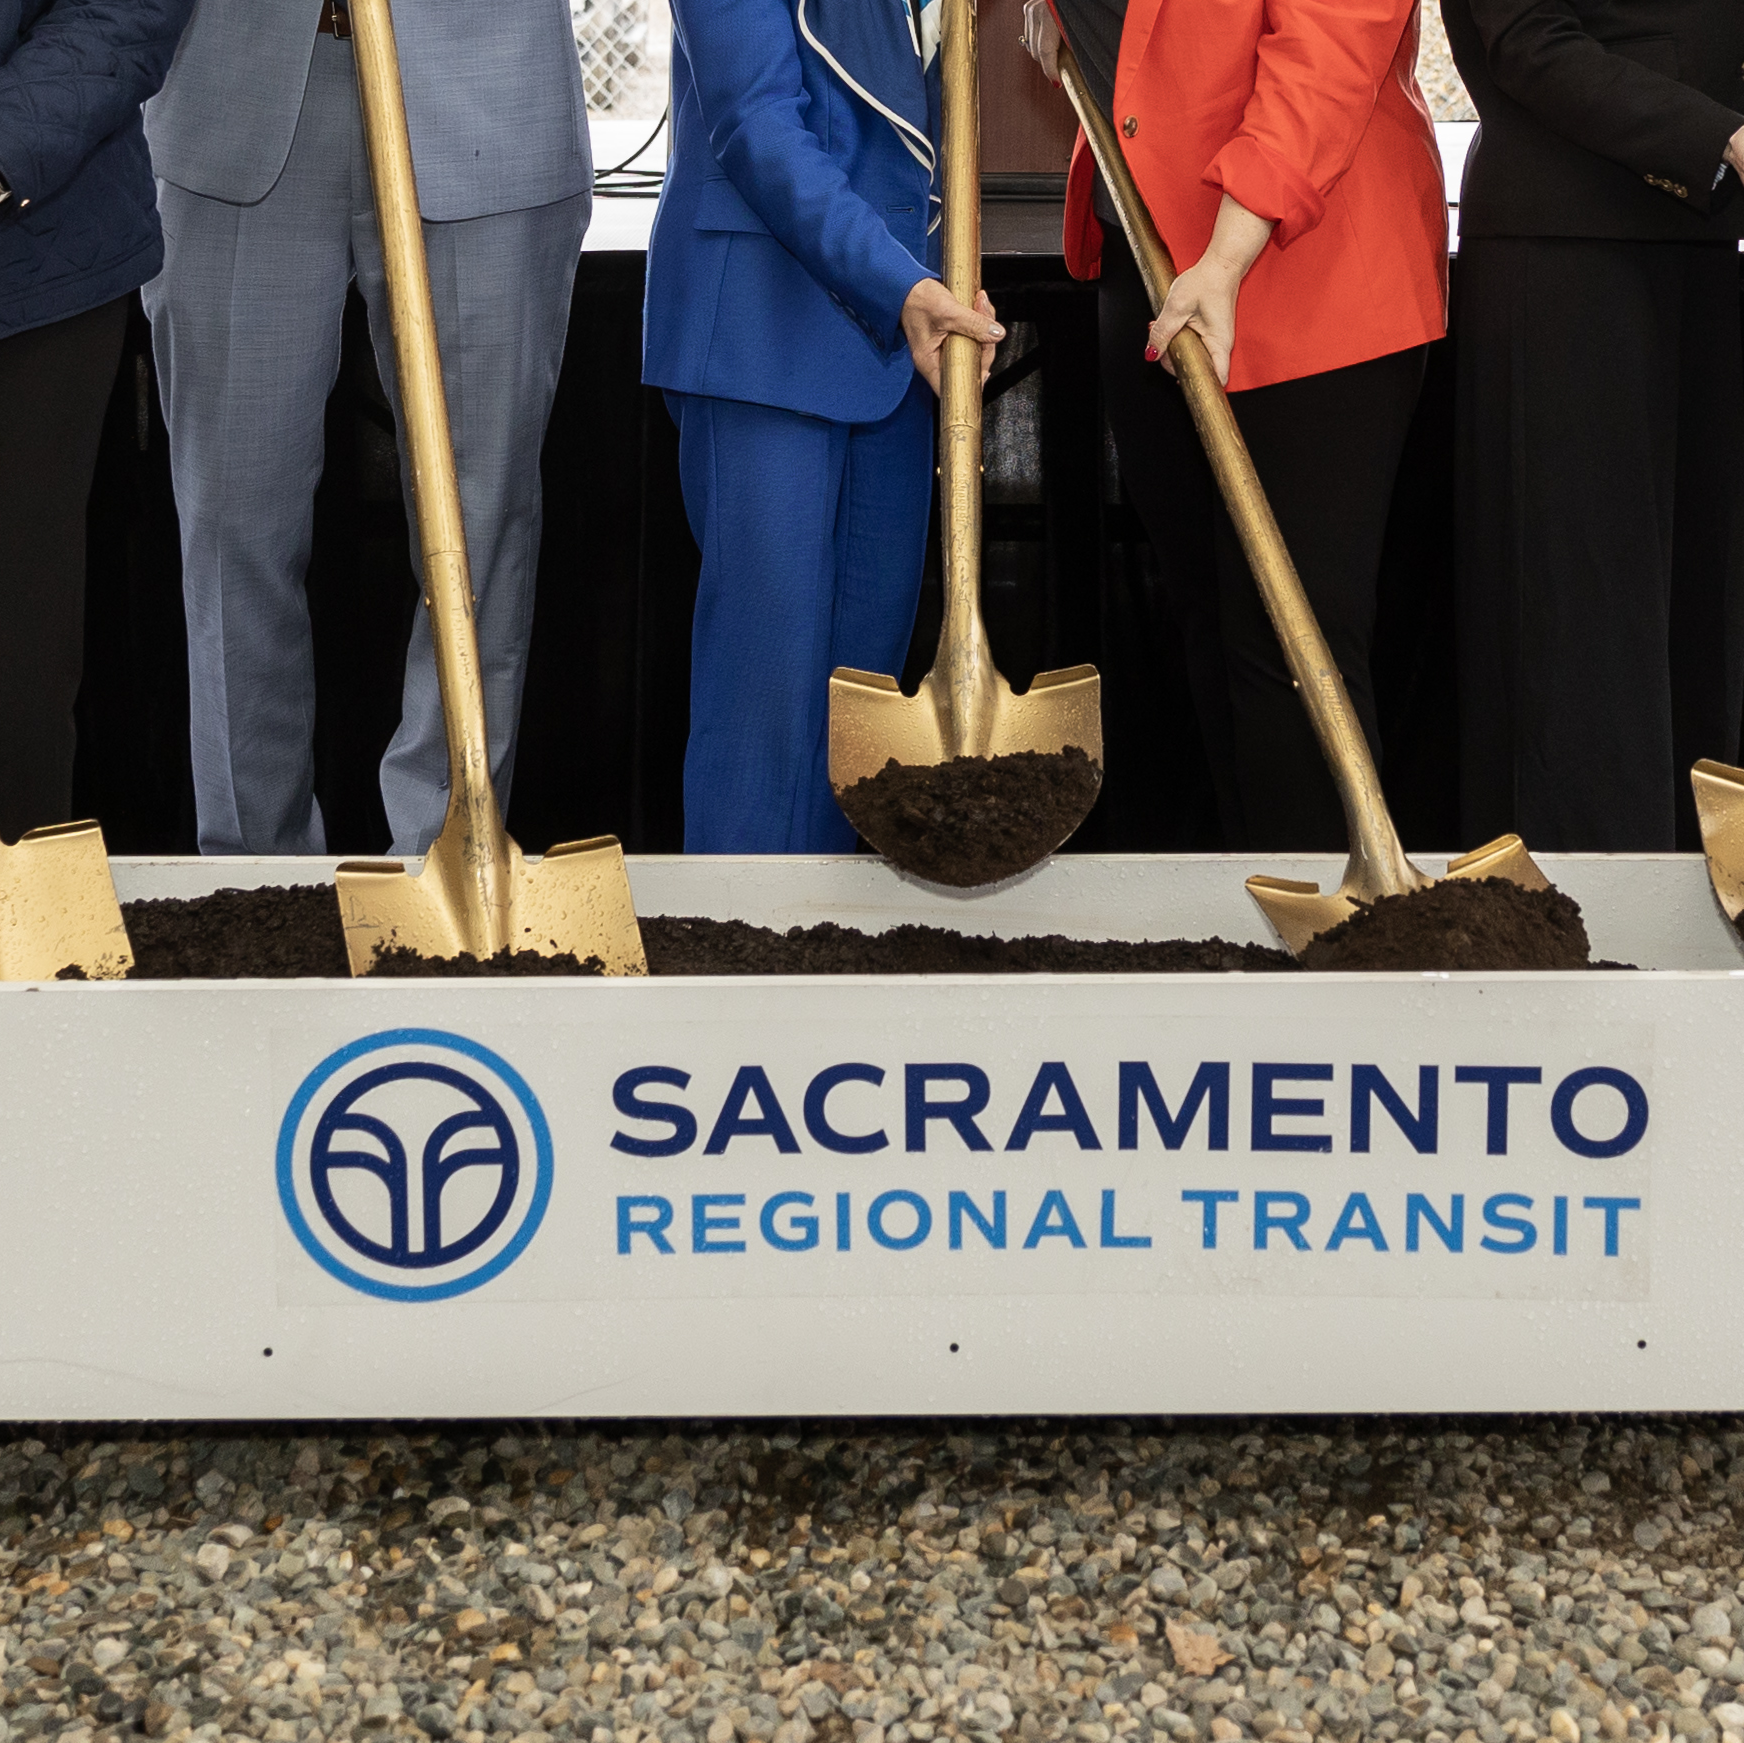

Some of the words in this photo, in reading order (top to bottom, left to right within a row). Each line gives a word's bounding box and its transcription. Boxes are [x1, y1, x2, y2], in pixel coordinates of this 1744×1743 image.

[609, 1060, 1650, 1159] SACRAMENTO
[615, 1188, 1153, 1255] REGIONAL
[1180, 1188, 1642, 1257] TRANSIT
